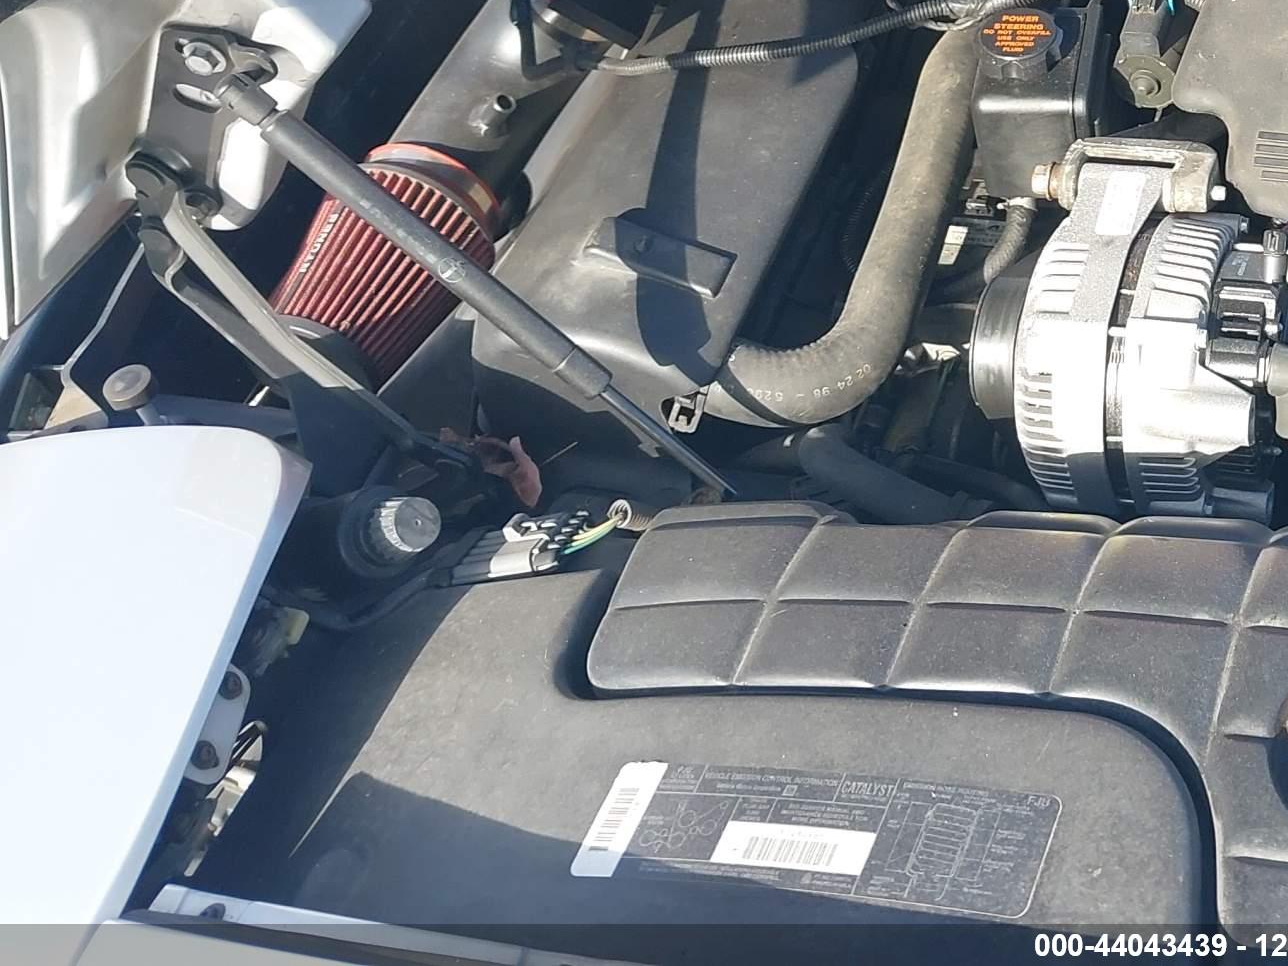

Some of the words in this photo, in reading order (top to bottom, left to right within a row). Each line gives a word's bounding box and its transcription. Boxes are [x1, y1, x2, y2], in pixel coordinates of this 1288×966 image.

[837, 375, 854, 390] 24
[813, 386, 831, 399] 98
[841, 781, 895, 797] CATALYST
